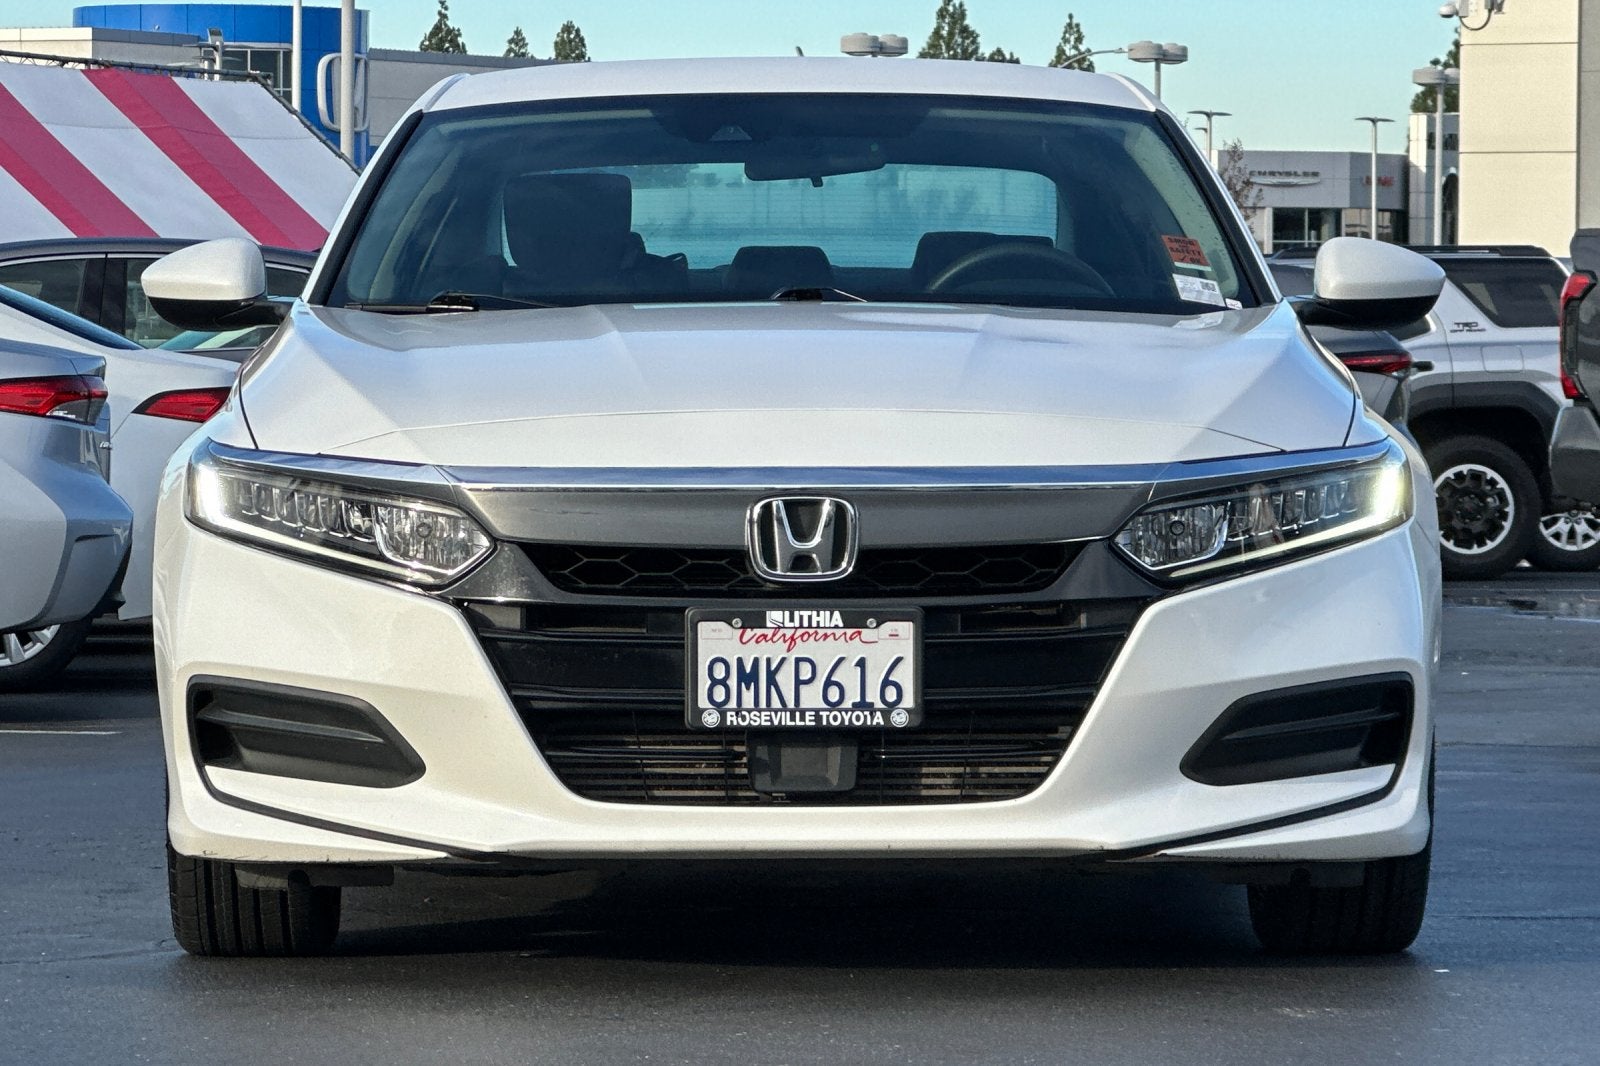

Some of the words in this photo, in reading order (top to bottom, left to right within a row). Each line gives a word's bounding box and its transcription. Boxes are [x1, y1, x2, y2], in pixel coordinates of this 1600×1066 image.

[783, 610, 844, 628] LITHIA
[739, 627, 879, 653] California
[706, 656, 904, 708] 8MKP616
[726, 710, 816, 726] ROSEVILLE
[822, 710, 885, 726] TOYOTA
